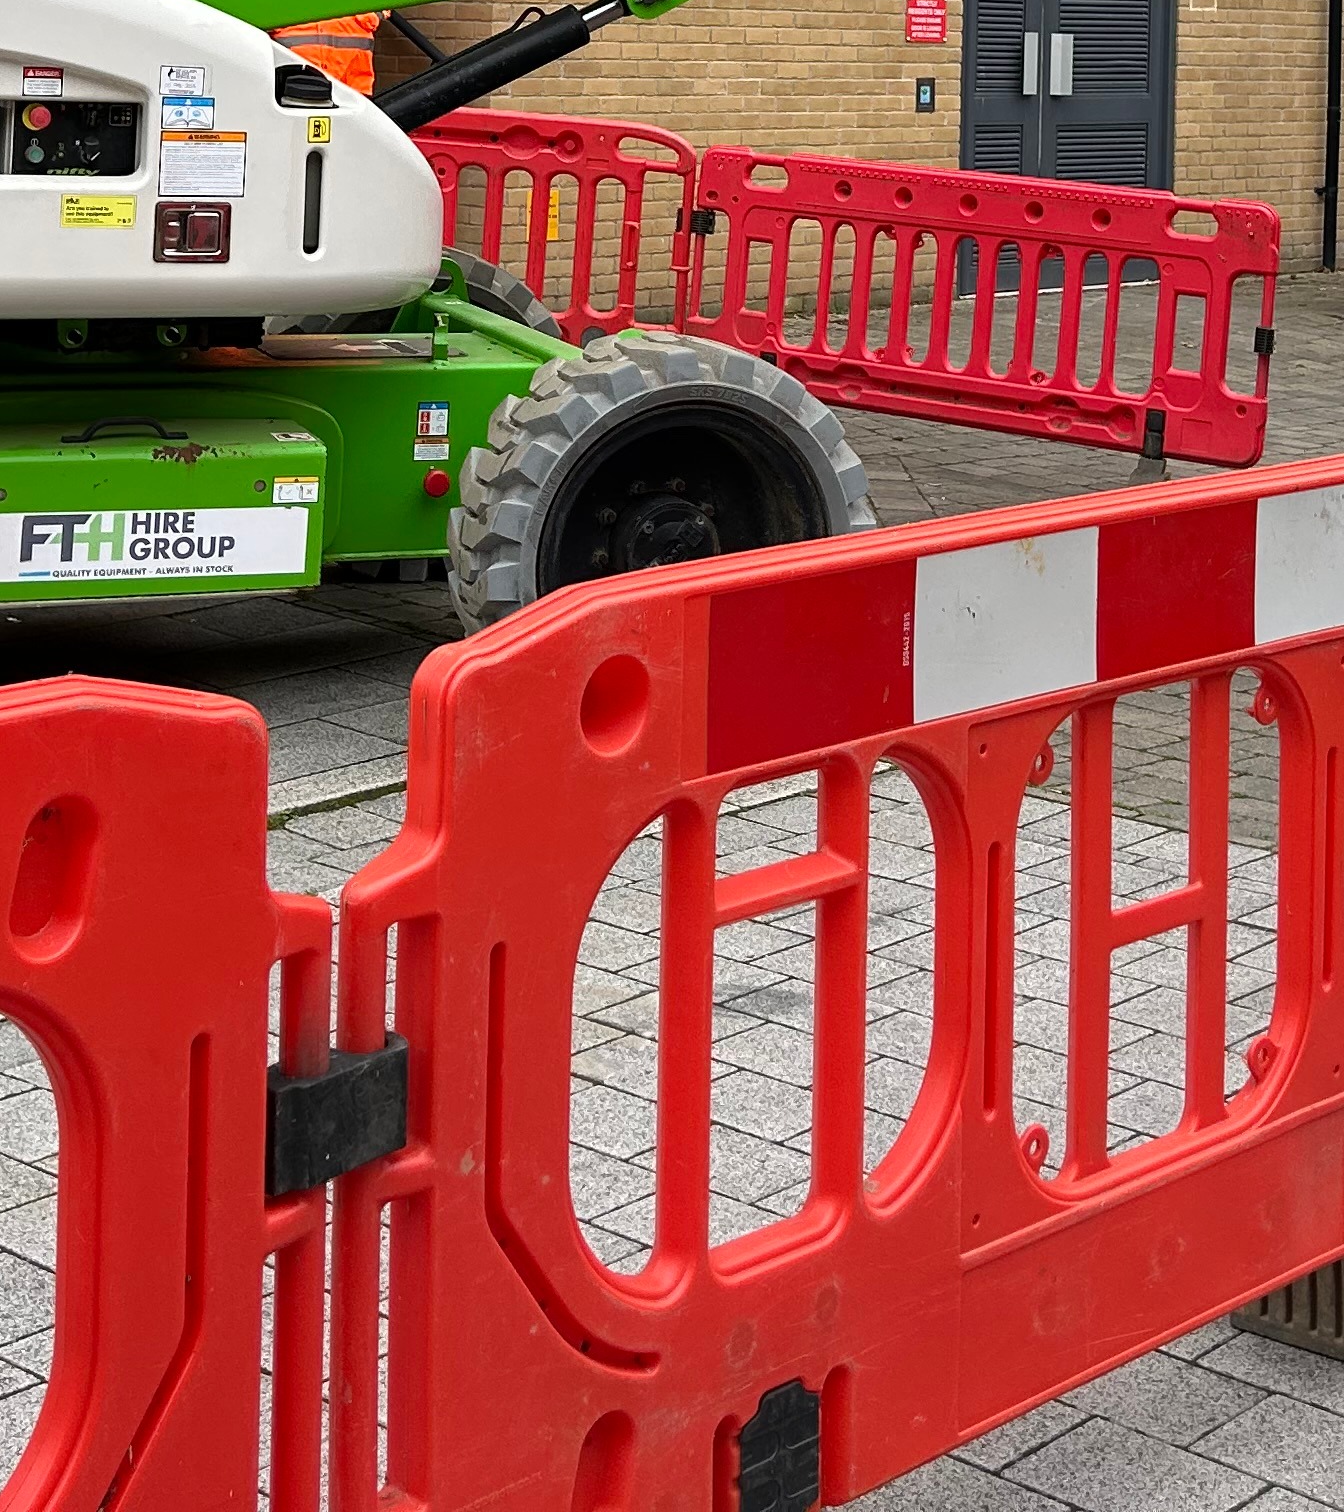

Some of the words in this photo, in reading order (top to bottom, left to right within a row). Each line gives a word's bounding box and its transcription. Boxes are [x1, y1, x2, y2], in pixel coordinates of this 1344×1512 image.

[19, 513, 126, 563] FTH
[131, 511, 196, 535] HIRE
[129, 535, 236, 561] GROUP
[52, 569, 92, 578] QUALITY
[93, 567, 147, 577] EQUIPMENT
[155, 566, 191, 576] ALWAYS
[192, 565, 203, 574] IN
[205, 565, 234, 574] STOCK
